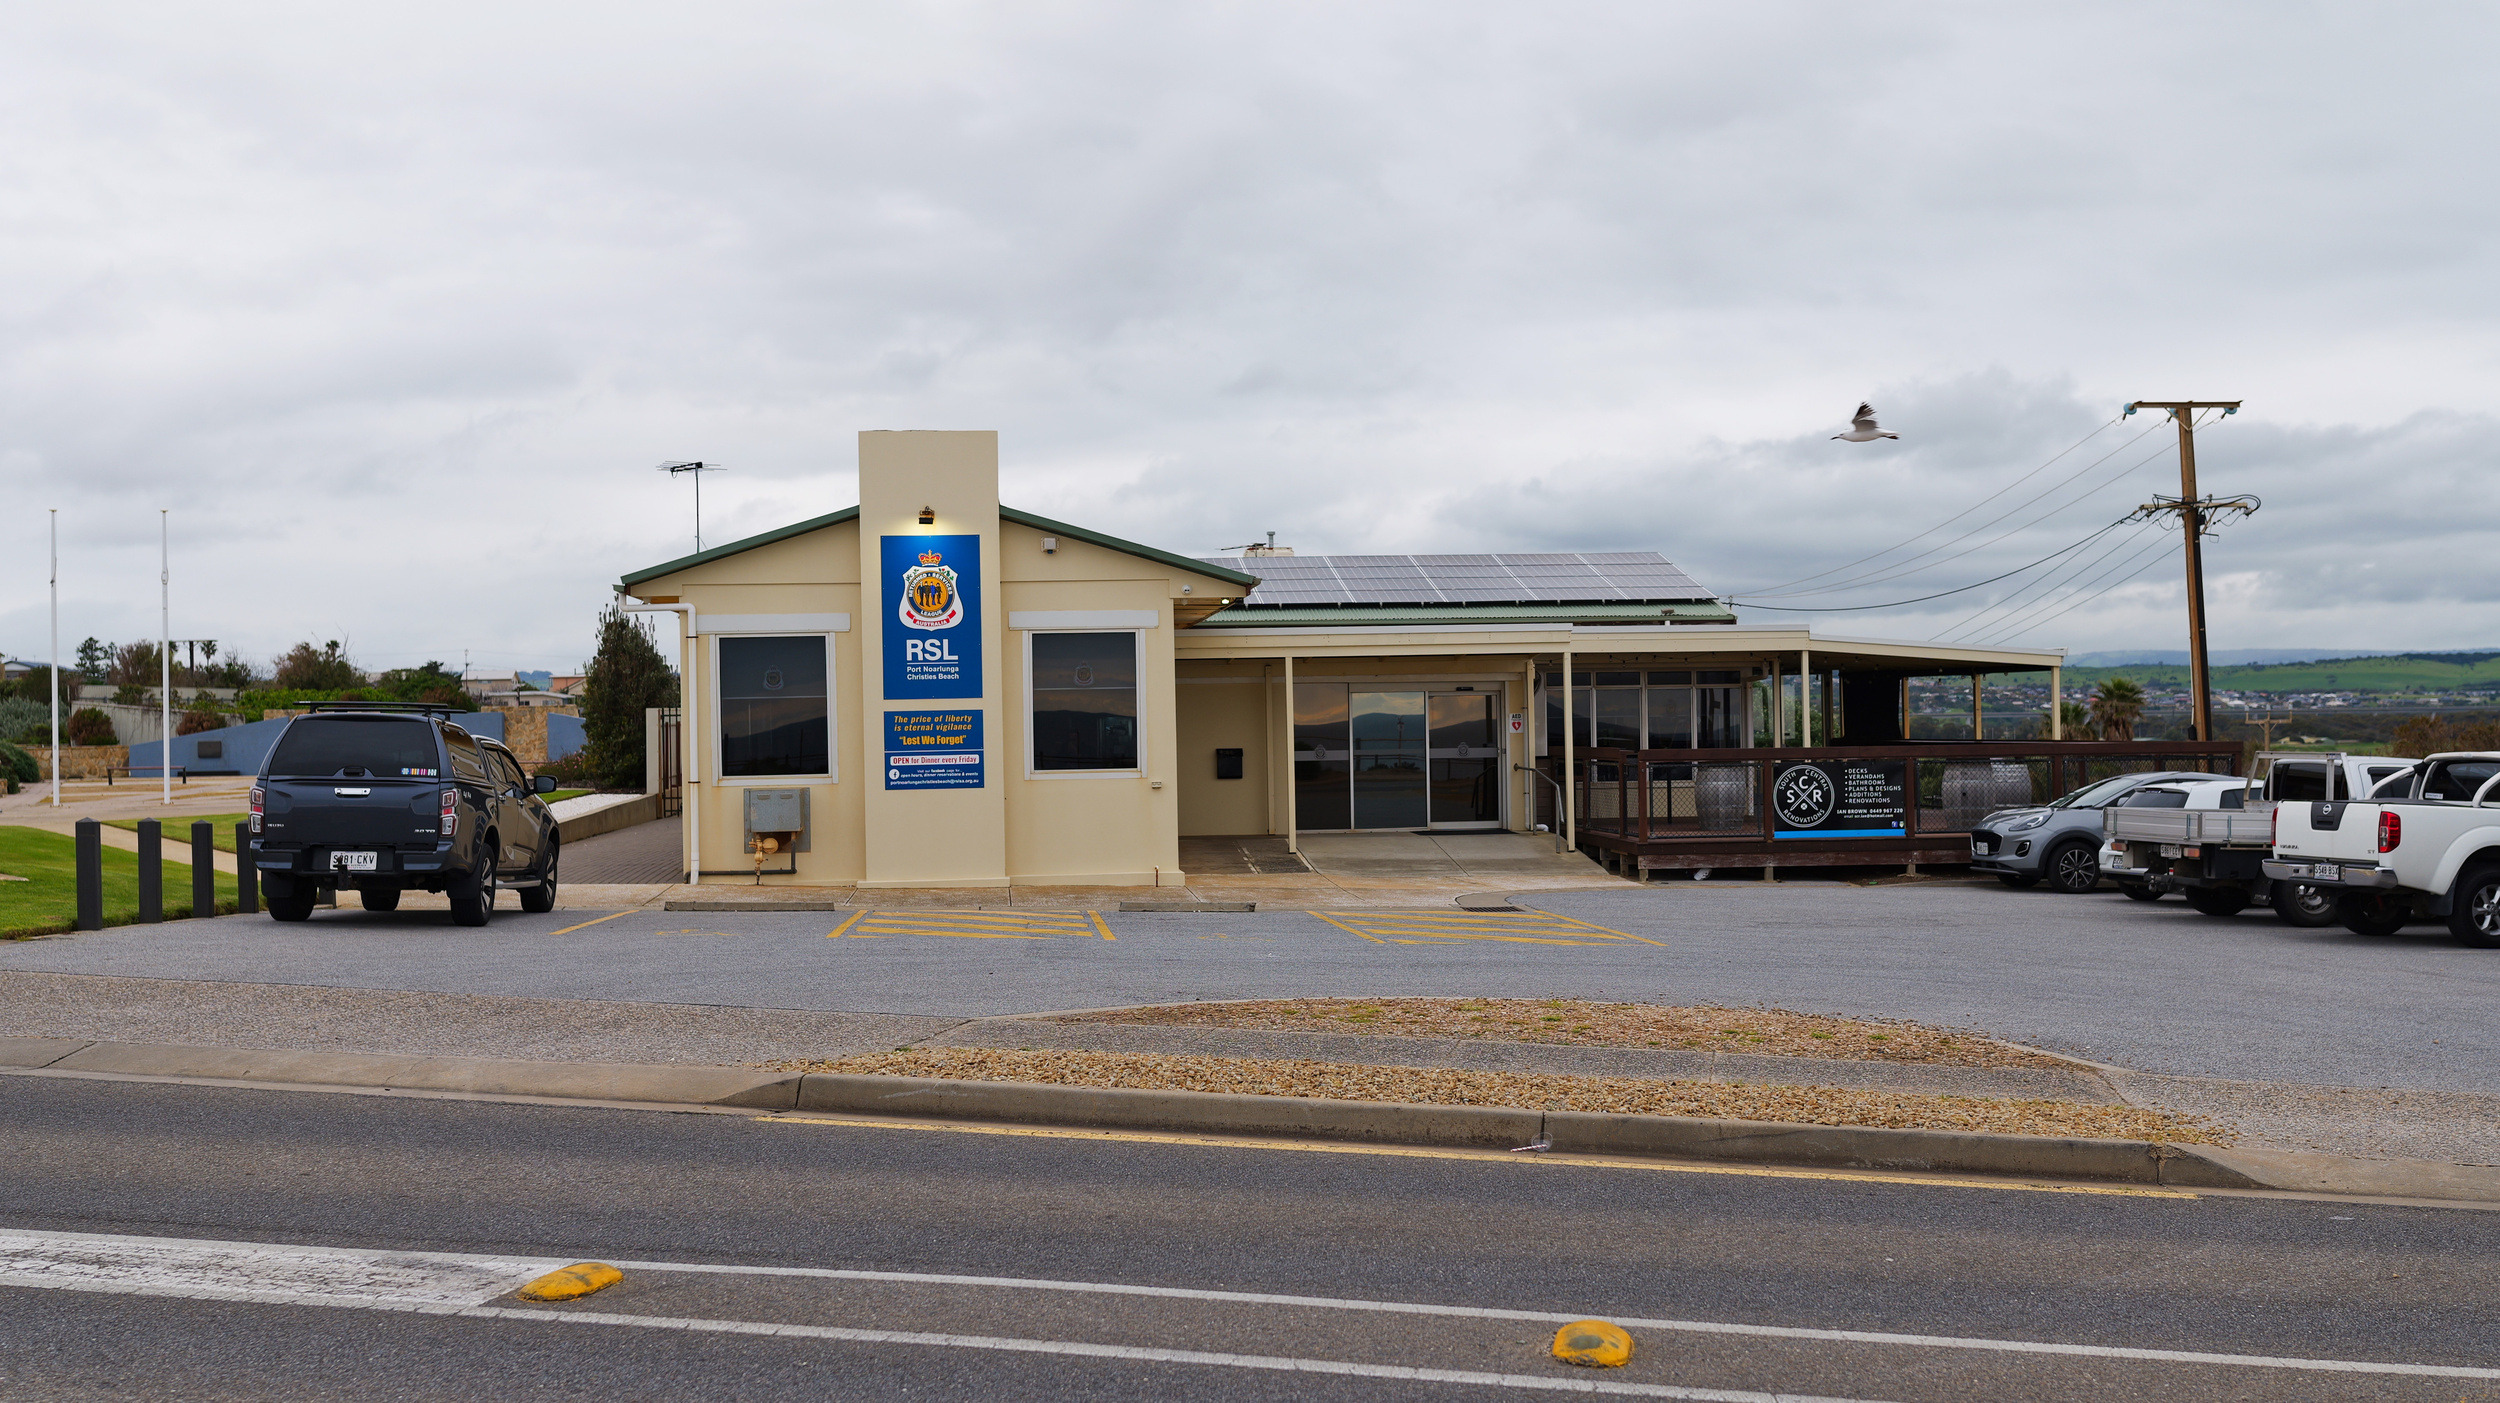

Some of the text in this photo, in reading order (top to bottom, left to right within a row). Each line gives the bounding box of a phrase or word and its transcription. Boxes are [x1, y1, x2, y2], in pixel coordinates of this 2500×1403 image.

[932, 572, 953, 594] SERVICES
[906, 639, 958, 661] RSL
[923, 666, 959, 674] Noarlunga
[910, 716, 931, 724] price
[945, 715, 972, 723] liberty
[936, 723, 972, 732] vigilance
[922, 736, 935, 744] We
[959, 756, 977, 764] Friday
[1779, 769, 1828, 791] SOUTH CENTRAL
[1799, 776, 1809, 789] C
[1787, 789, 1823, 803] S R
[1783, 809, 1825, 823] RENOVATIONS
